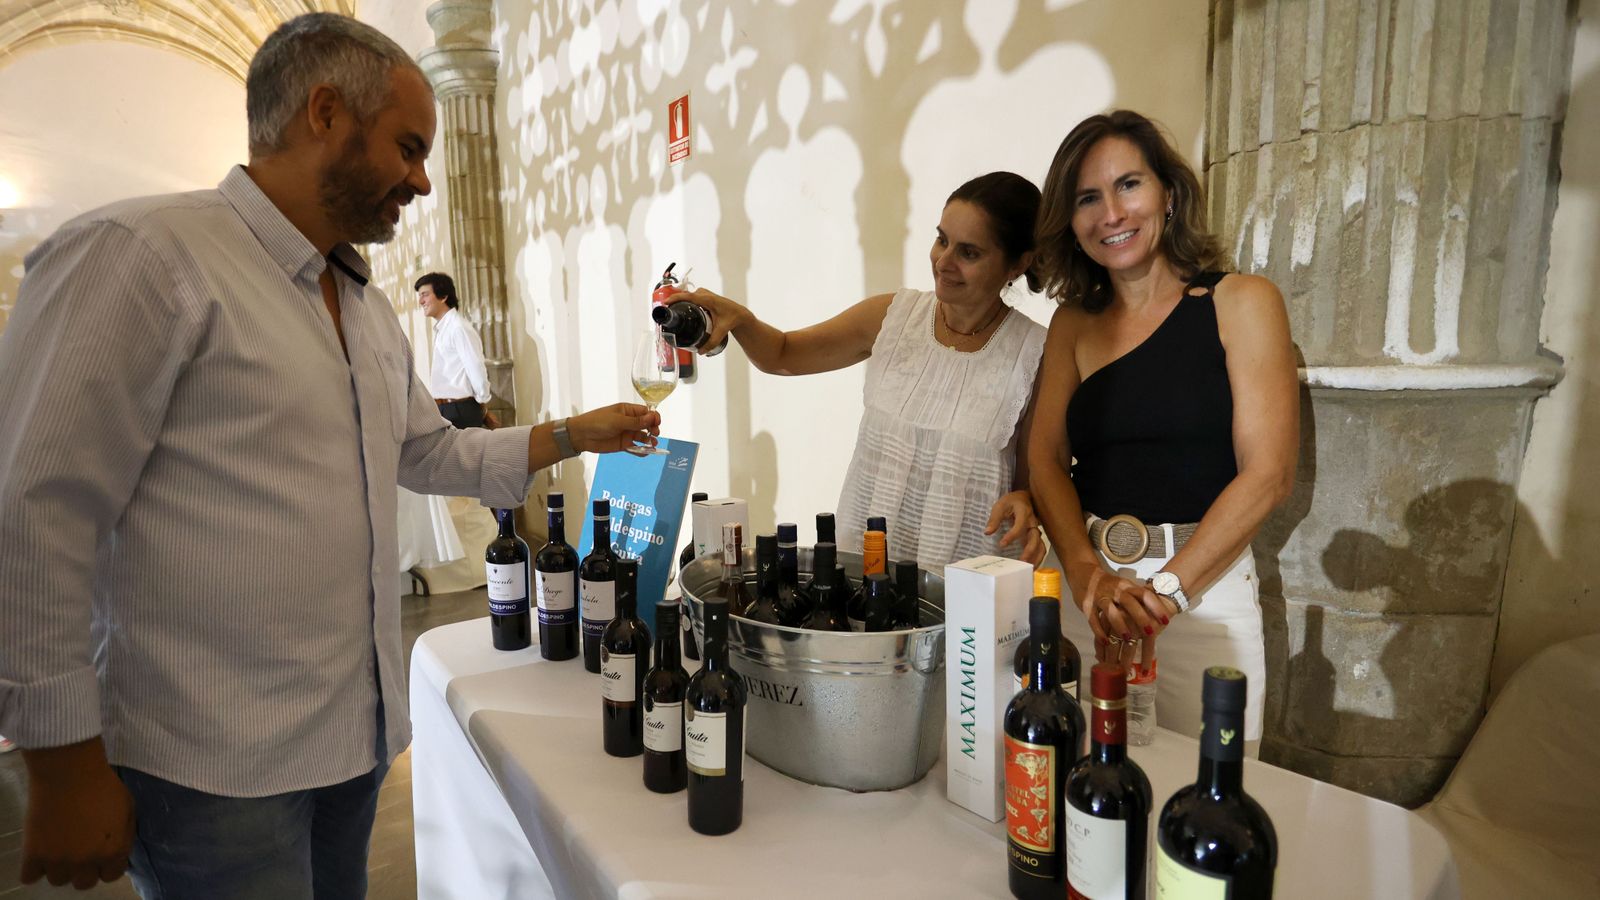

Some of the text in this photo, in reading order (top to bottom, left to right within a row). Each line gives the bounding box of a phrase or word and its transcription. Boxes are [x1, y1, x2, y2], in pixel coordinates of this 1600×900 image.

[602, 490, 652, 517] Bodegas
[609, 517, 664, 545] ldespino
[743, 675, 803, 707] JEREZ
[960, 625, 976, 761] MAXIMUM
